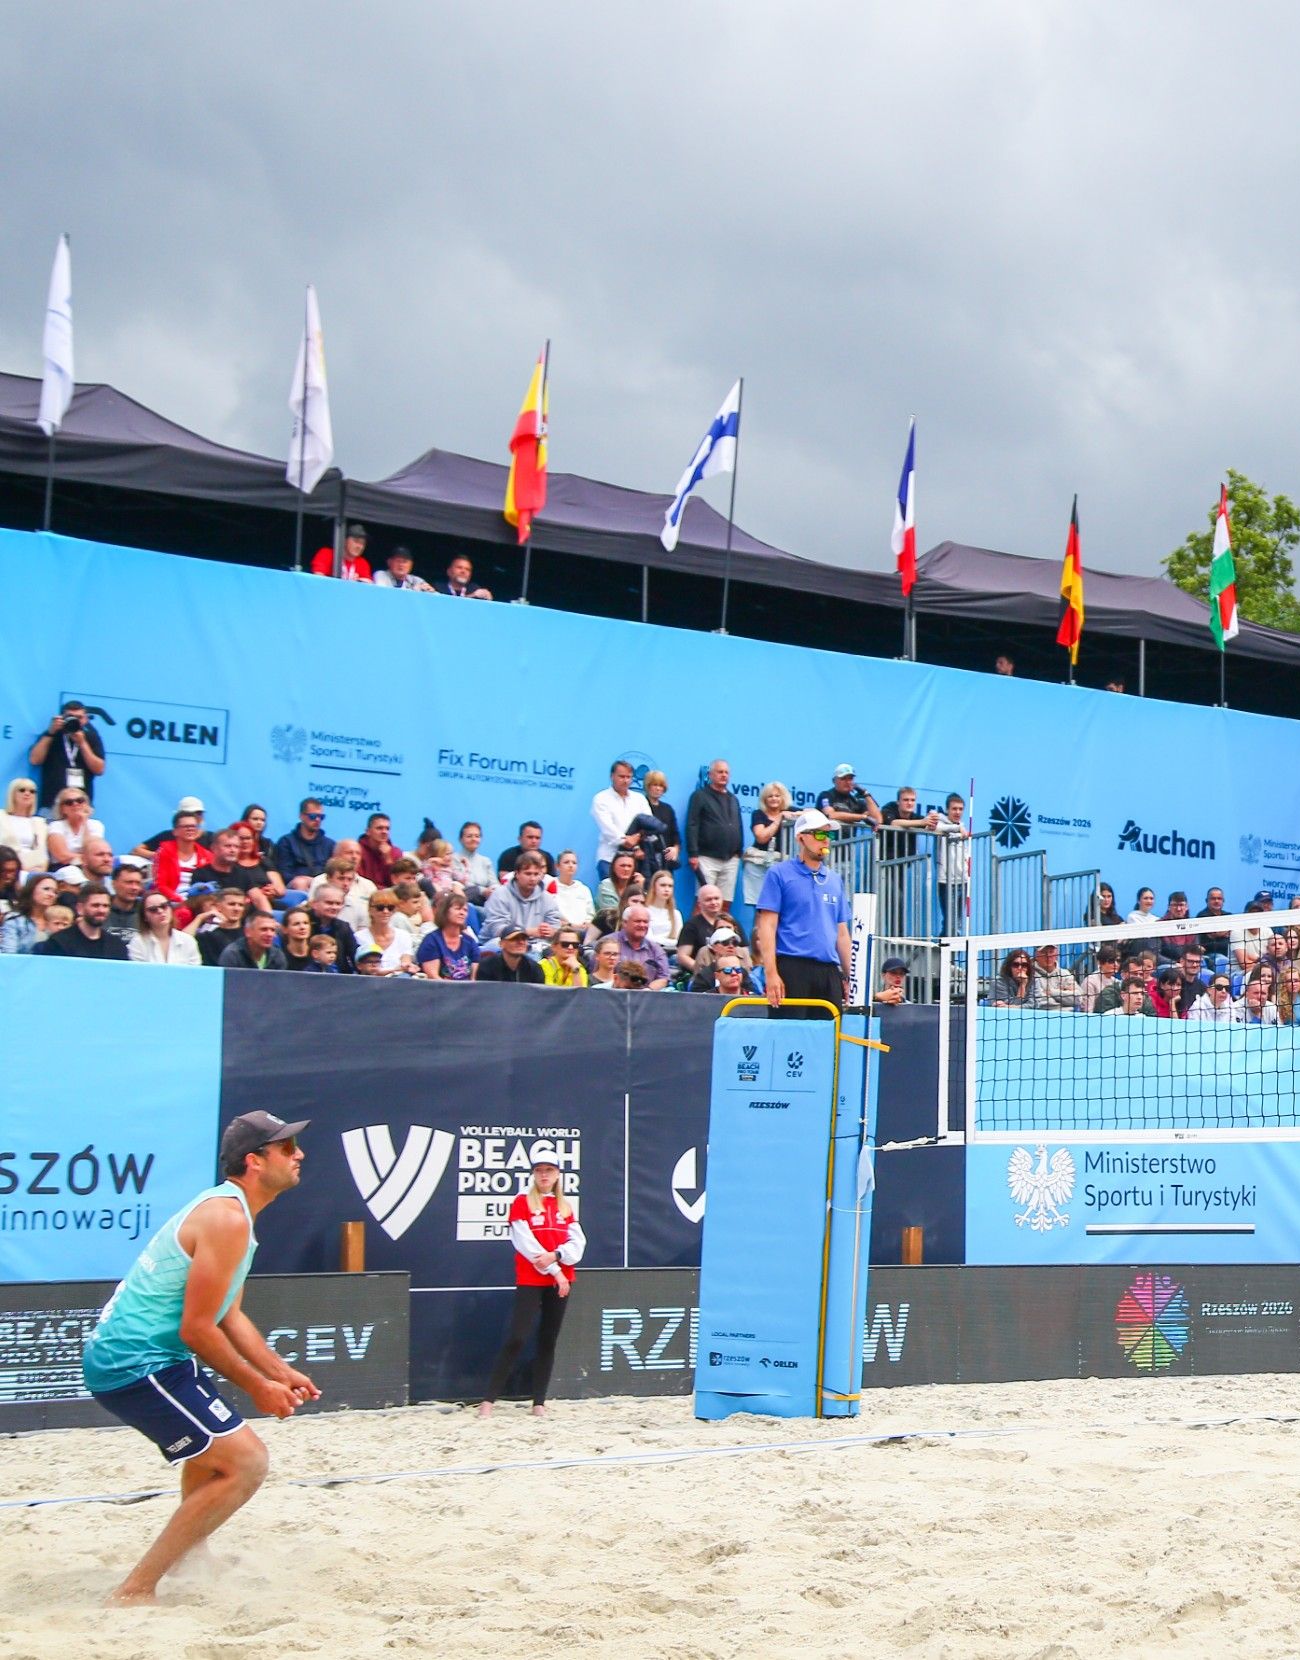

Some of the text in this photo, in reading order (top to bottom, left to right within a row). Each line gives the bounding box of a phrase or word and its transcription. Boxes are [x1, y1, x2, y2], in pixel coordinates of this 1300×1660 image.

[126, 717, 218, 746] ORLEN
[438, 749, 575, 778] Fix Forum Lider
[1072, 818, 1091, 829] 2026
[1117, 819, 1216, 860] Auchan
[786, 1070, 803, 1078] CEV
[460, 1126, 580, 1138] VOLLEYBALL WORLD
[1084, 1151, 1216, 1175] Ministerstwo
[458, 1171, 513, 1193] PRO
[1084, 1184, 1257, 1211] Sportu i Turystyki
[1261, 1301, 1293, 1315] 2026
[266, 1322, 375, 1362] CEV
[773, 1360, 798, 1369] ORLEN
